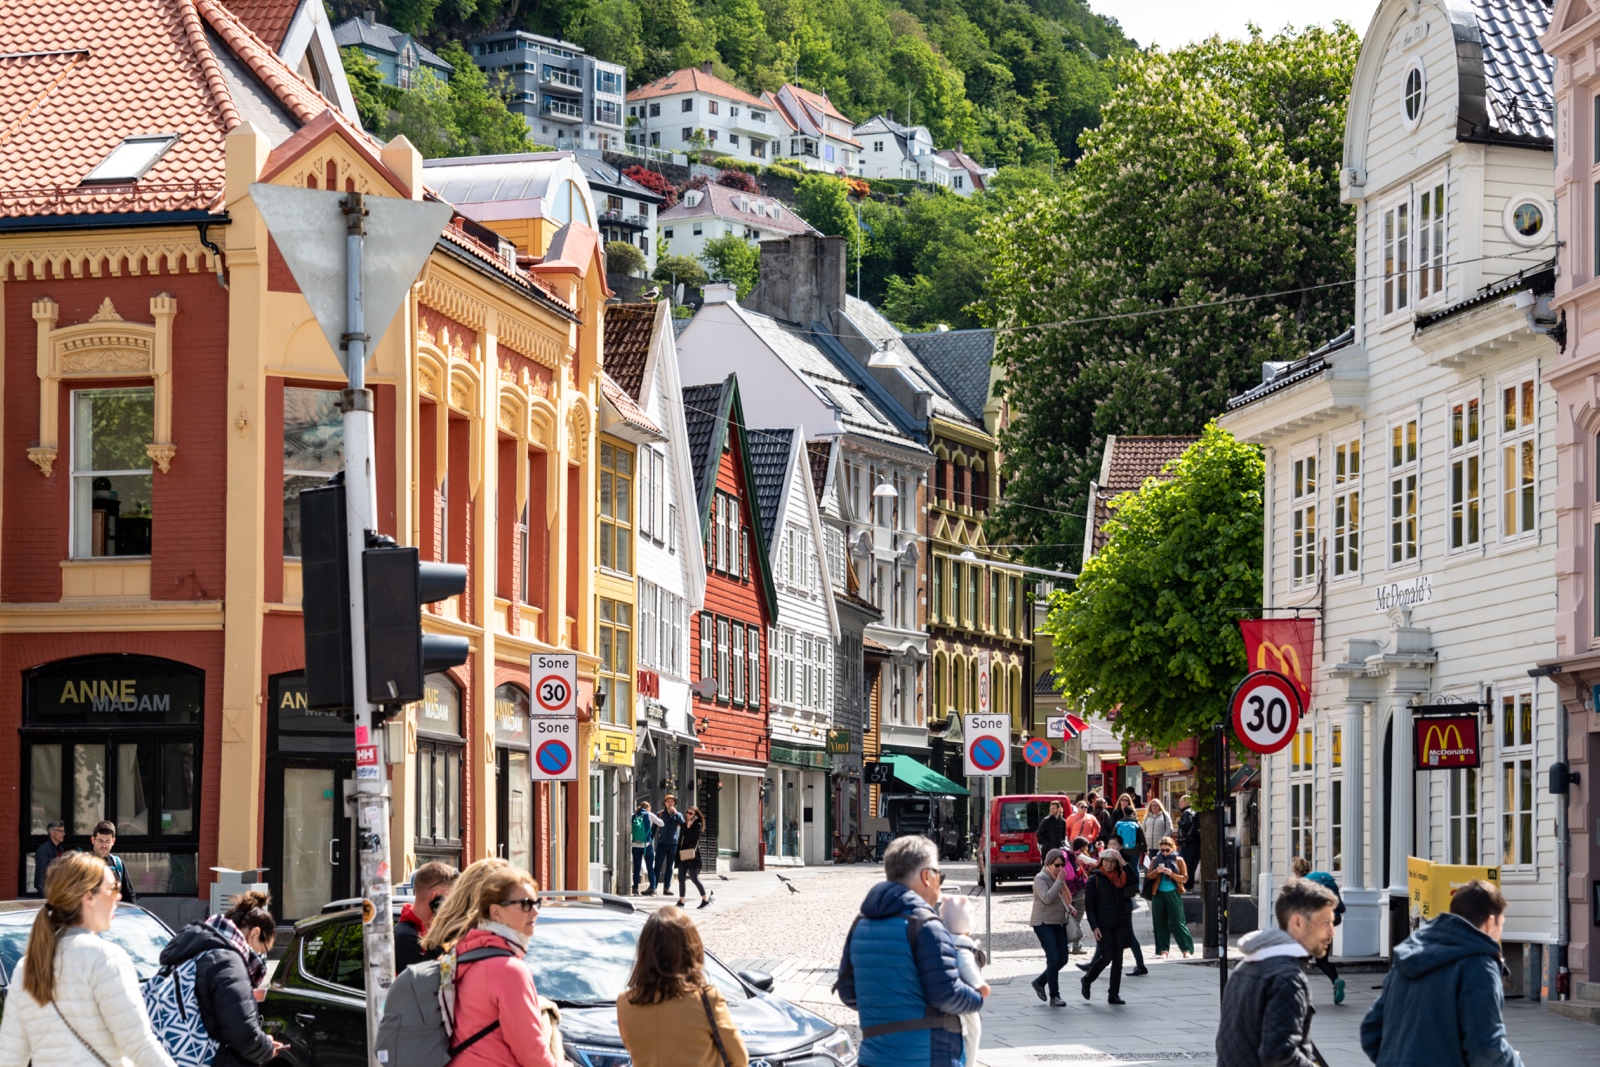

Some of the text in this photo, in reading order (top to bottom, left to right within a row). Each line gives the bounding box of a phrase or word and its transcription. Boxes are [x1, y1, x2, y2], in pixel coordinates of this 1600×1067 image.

[1375, 576, 1433, 611] McDonald's
[538, 657, 570, 669] Sone
[59, 680, 137, 704] ANNE
[542, 684, 566, 702] 30
[92, 694, 170, 712] MADAM
[424, 701, 449, 721] MADAM
[495, 700, 515, 721] ANNE
[971, 717, 1003, 729] Sone
[1246, 695, 1288, 734] 30
[538, 722, 570, 733] Sone
[830, 742, 849, 752] Vinyl
